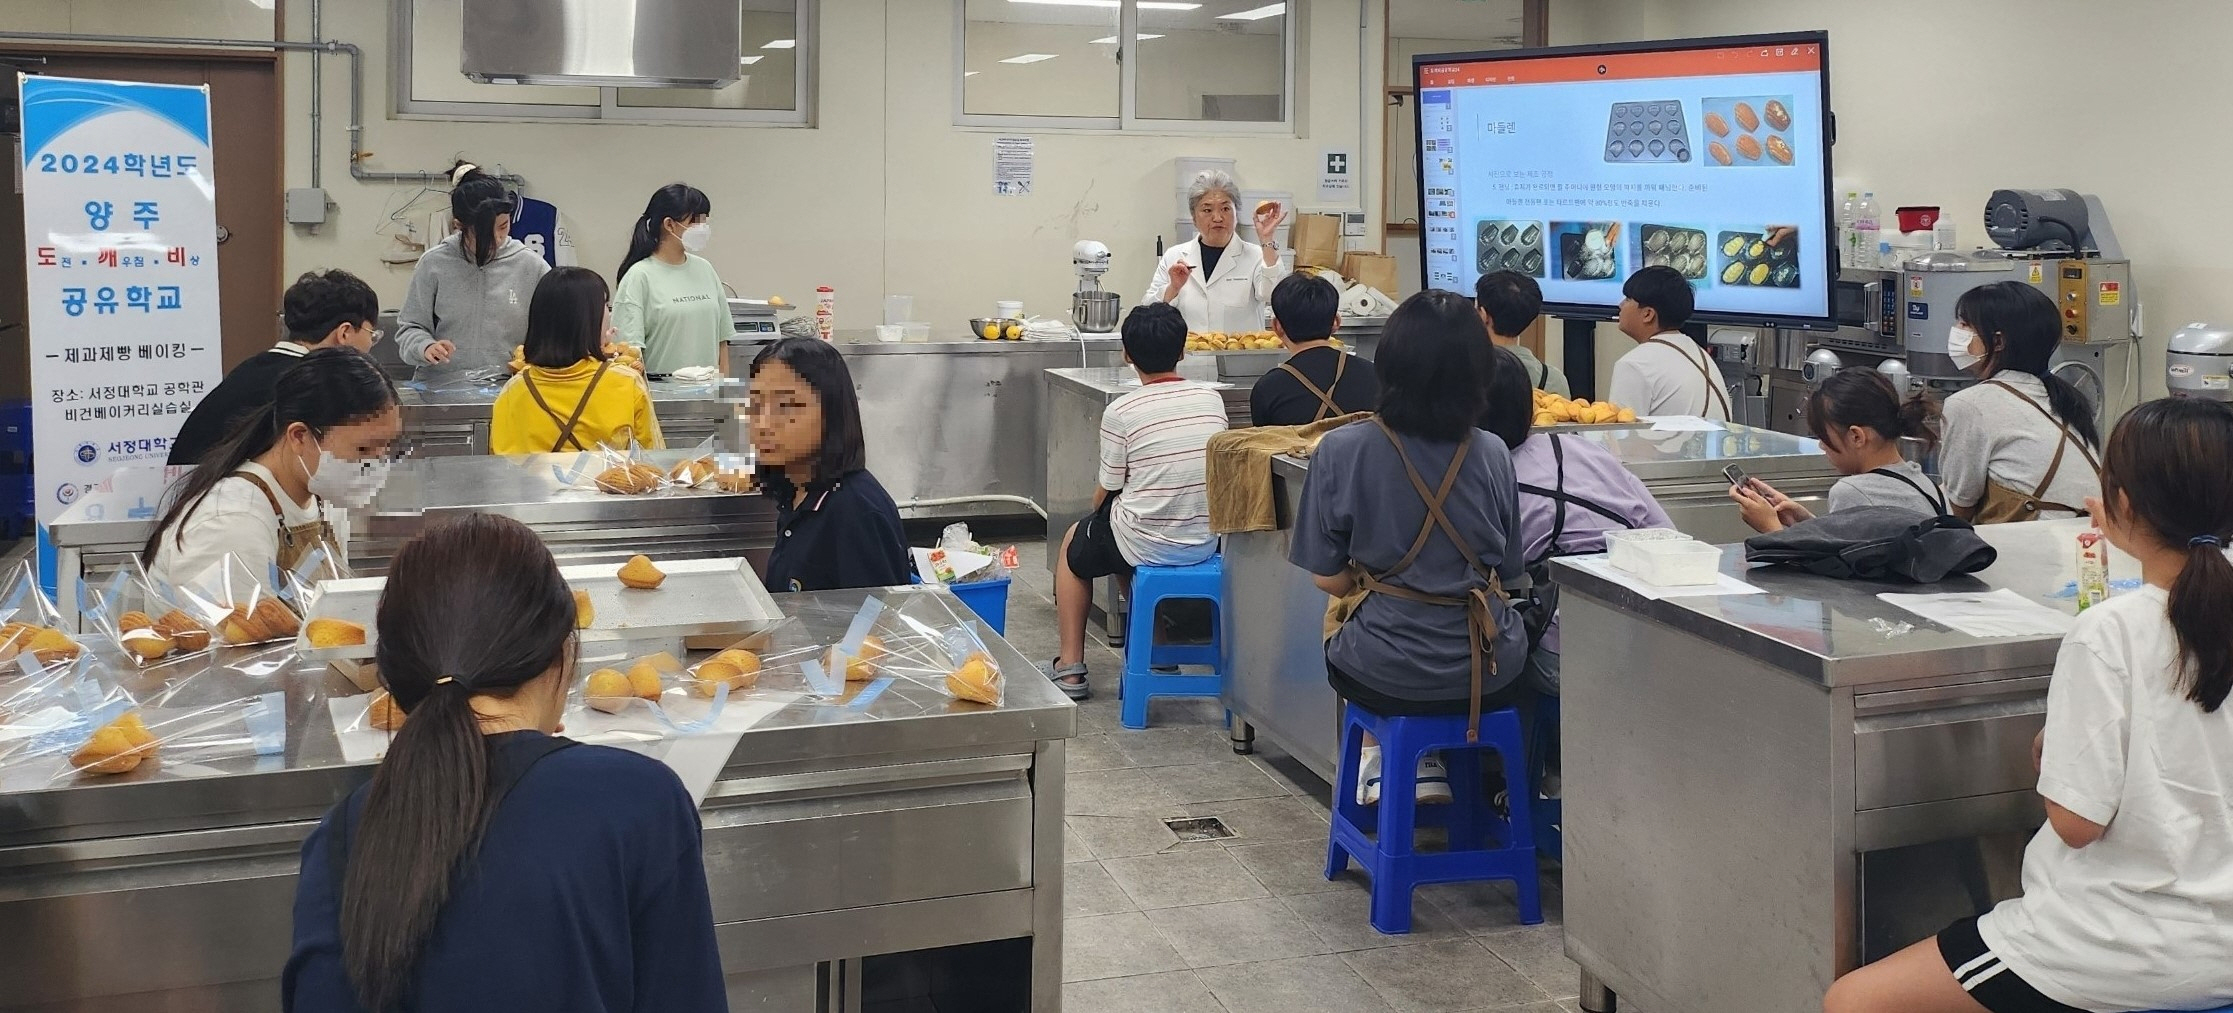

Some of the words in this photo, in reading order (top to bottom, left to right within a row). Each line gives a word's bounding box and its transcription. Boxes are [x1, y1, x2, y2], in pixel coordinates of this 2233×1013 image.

[1487, 121, 1516, 134] 마들렌
[41, 152, 198, 178] 2024학년도
[61, 285, 183, 317] 공유학교
[672, 293, 712, 304] NATIONAL
[64, 345, 132, 364] 제과제빵
[138, 342, 187, 360] 베이킹
[51, 386, 84, 403] 장소:
[88, 382, 158, 401] 서정대학교
[163, 380, 205, 395] 공학관
[65, 400, 192, 422] 비건베이커리실습실
